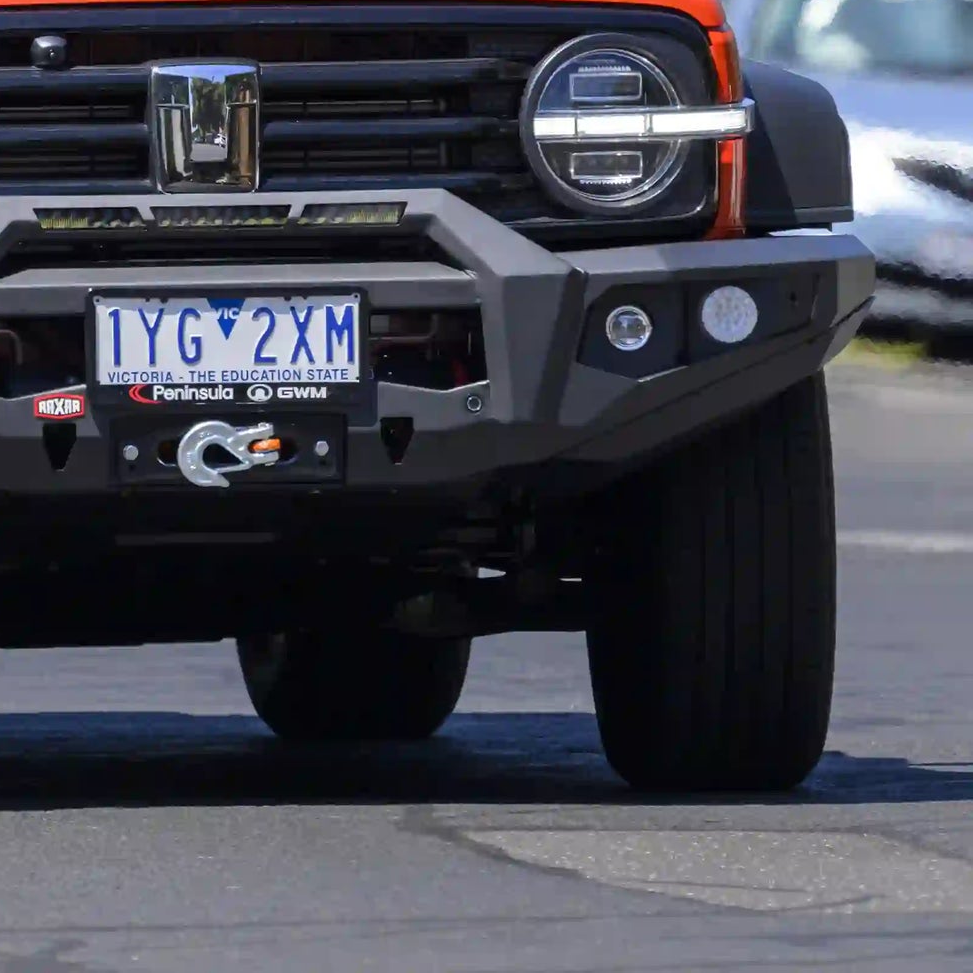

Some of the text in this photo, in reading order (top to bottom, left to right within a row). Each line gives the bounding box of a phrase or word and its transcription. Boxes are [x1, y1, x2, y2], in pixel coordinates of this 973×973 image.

[107, 304, 355, 367] 1YG 2XM
[108, 371, 174, 383] VICTORIA
[188, 370, 216, 382] THE
[221, 369, 302, 382] EDUCATION
[306, 368, 349, 381] STATE
[152, 384, 327, 401] Peninsula GWM
